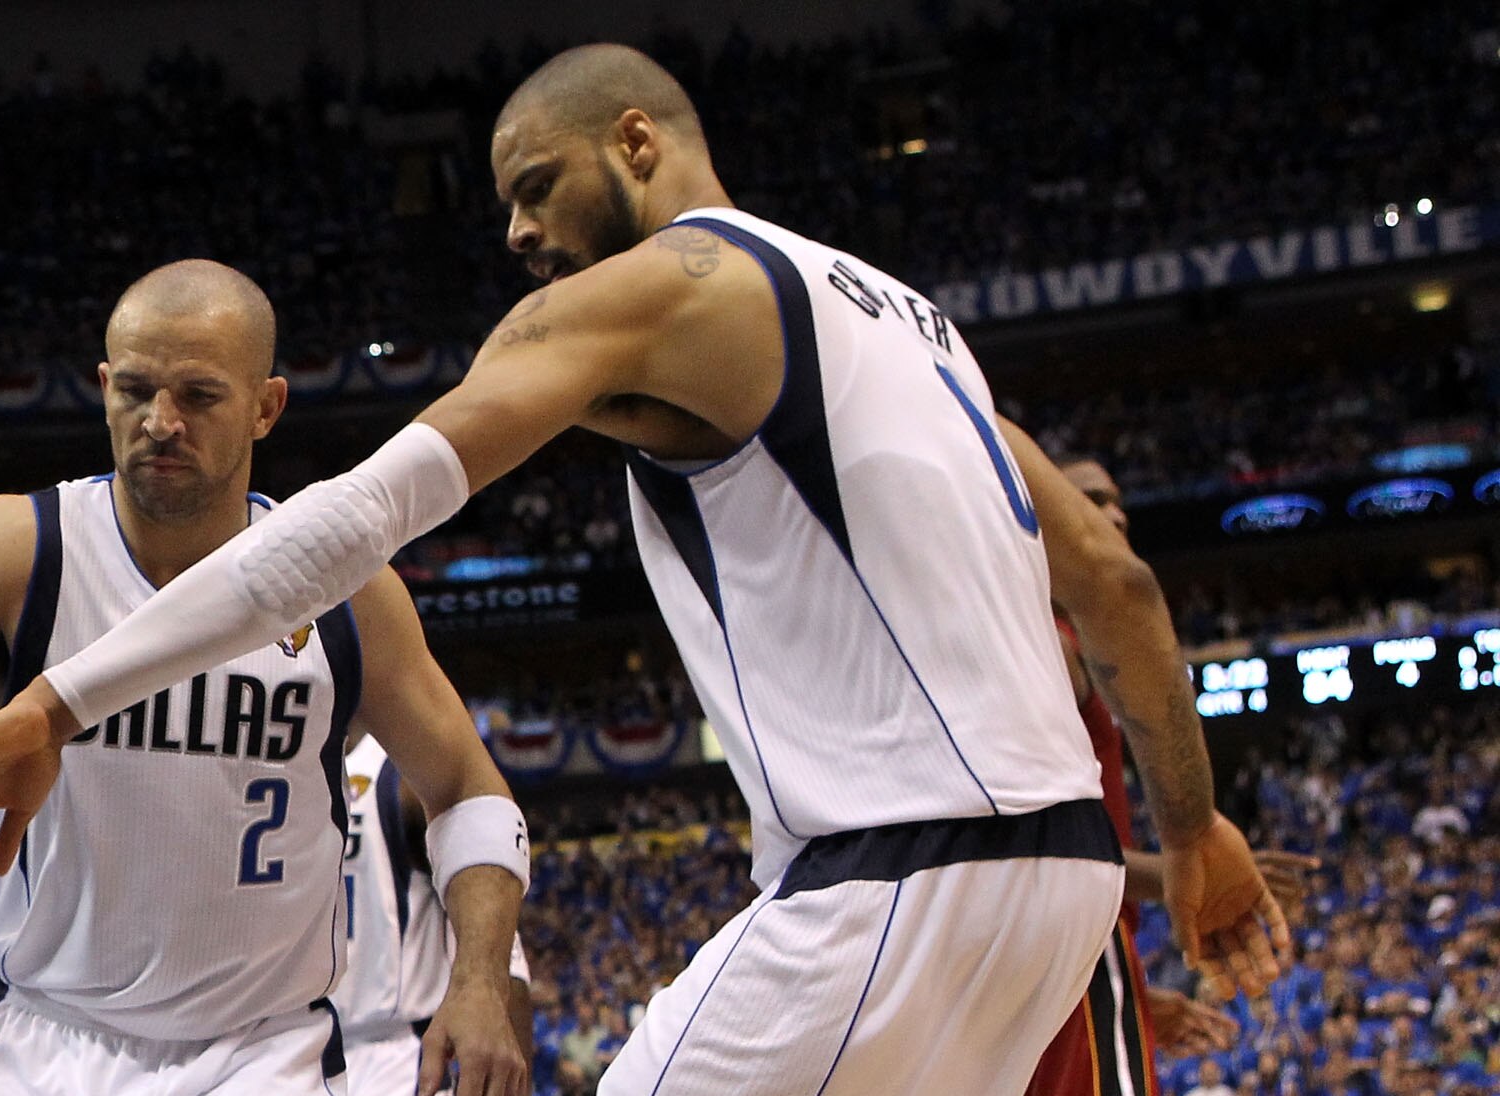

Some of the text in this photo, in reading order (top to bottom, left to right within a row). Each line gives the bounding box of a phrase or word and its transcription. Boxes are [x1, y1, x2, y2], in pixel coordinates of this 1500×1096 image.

[934, 205, 1484, 325] ROWDYVILLE
[69, 672, 313, 762] ALLAS
[236, 777, 290, 888] 2
